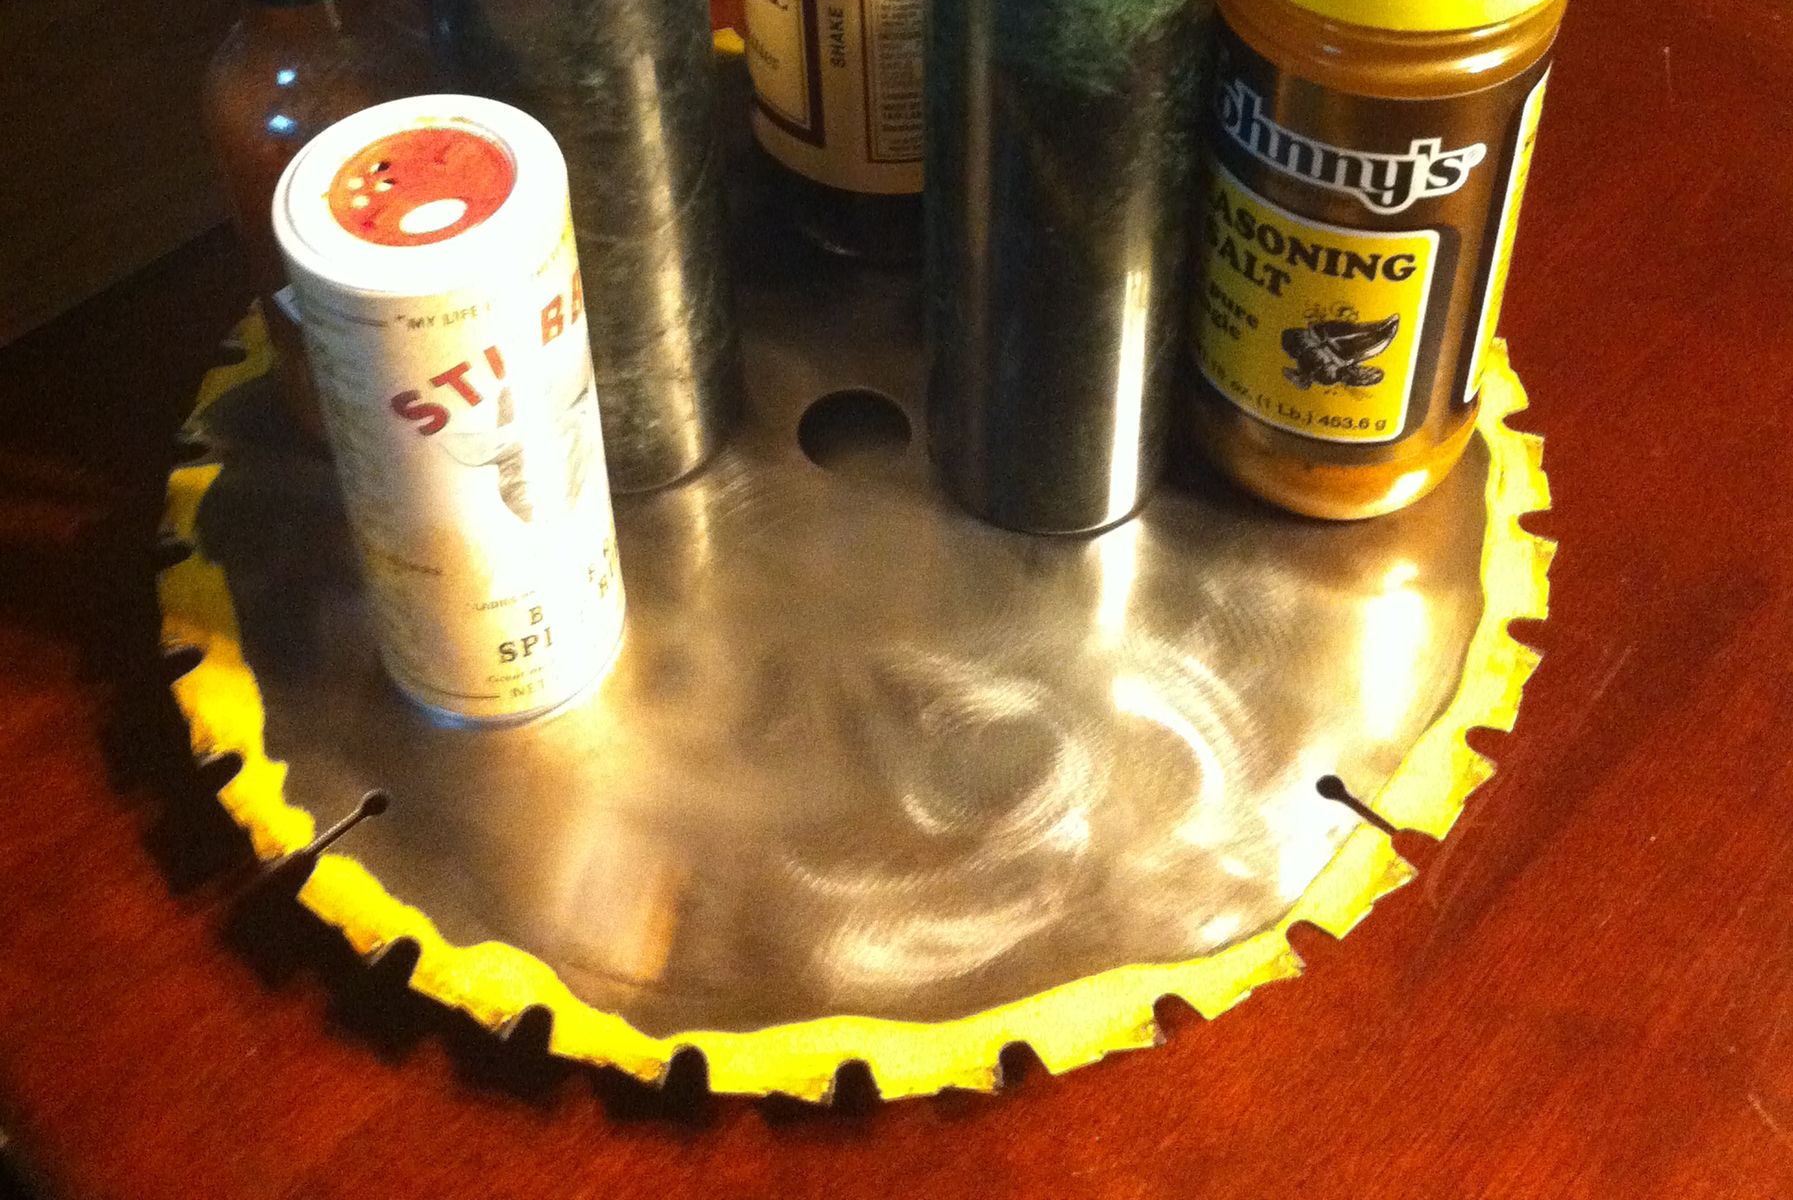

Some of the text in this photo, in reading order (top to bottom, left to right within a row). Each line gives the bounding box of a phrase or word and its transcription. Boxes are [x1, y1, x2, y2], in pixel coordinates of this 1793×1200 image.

[828, 7, 847, 70] SHAKE
[1220, 78, 1467, 213] ohnny's
[1211, 187, 1417, 283] ASONING
[442, 304, 478, 326] LIFE
[1318, 414, 1371, 433] 453.6
[1375, 418, 1388, 434] g
